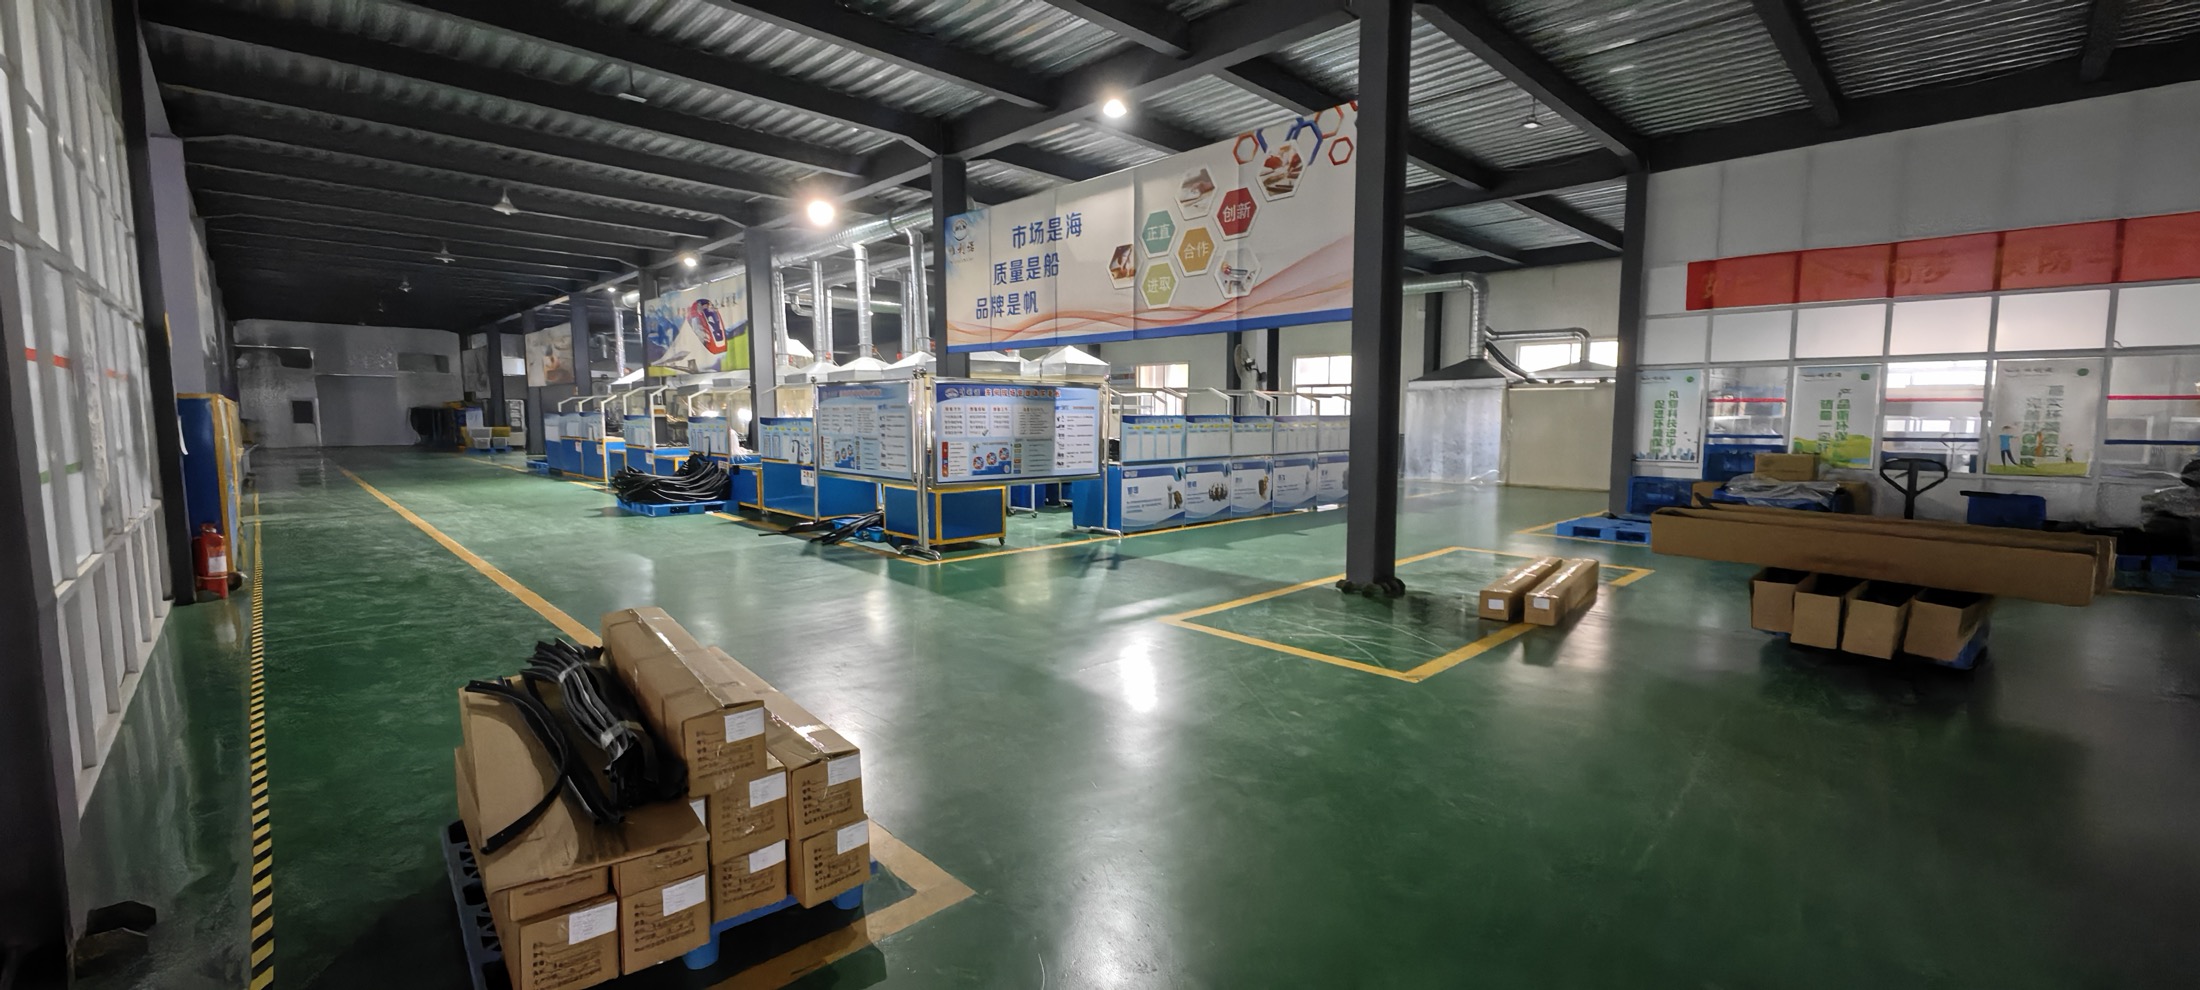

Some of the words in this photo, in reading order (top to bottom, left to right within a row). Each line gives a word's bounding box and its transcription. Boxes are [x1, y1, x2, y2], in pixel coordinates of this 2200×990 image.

[1222, 201, 1252, 223] 创新
[1012, 212, 1083, 249] 市场是海
[1146, 223, 1171, 241] 正直
[1183, 242, 1210, 260] 合作
[993, 252, 1060, 286] 质量是船
[1147, 276, 1172, 293] 进取
[975, 290, 1039, 320] 品牌是帆
